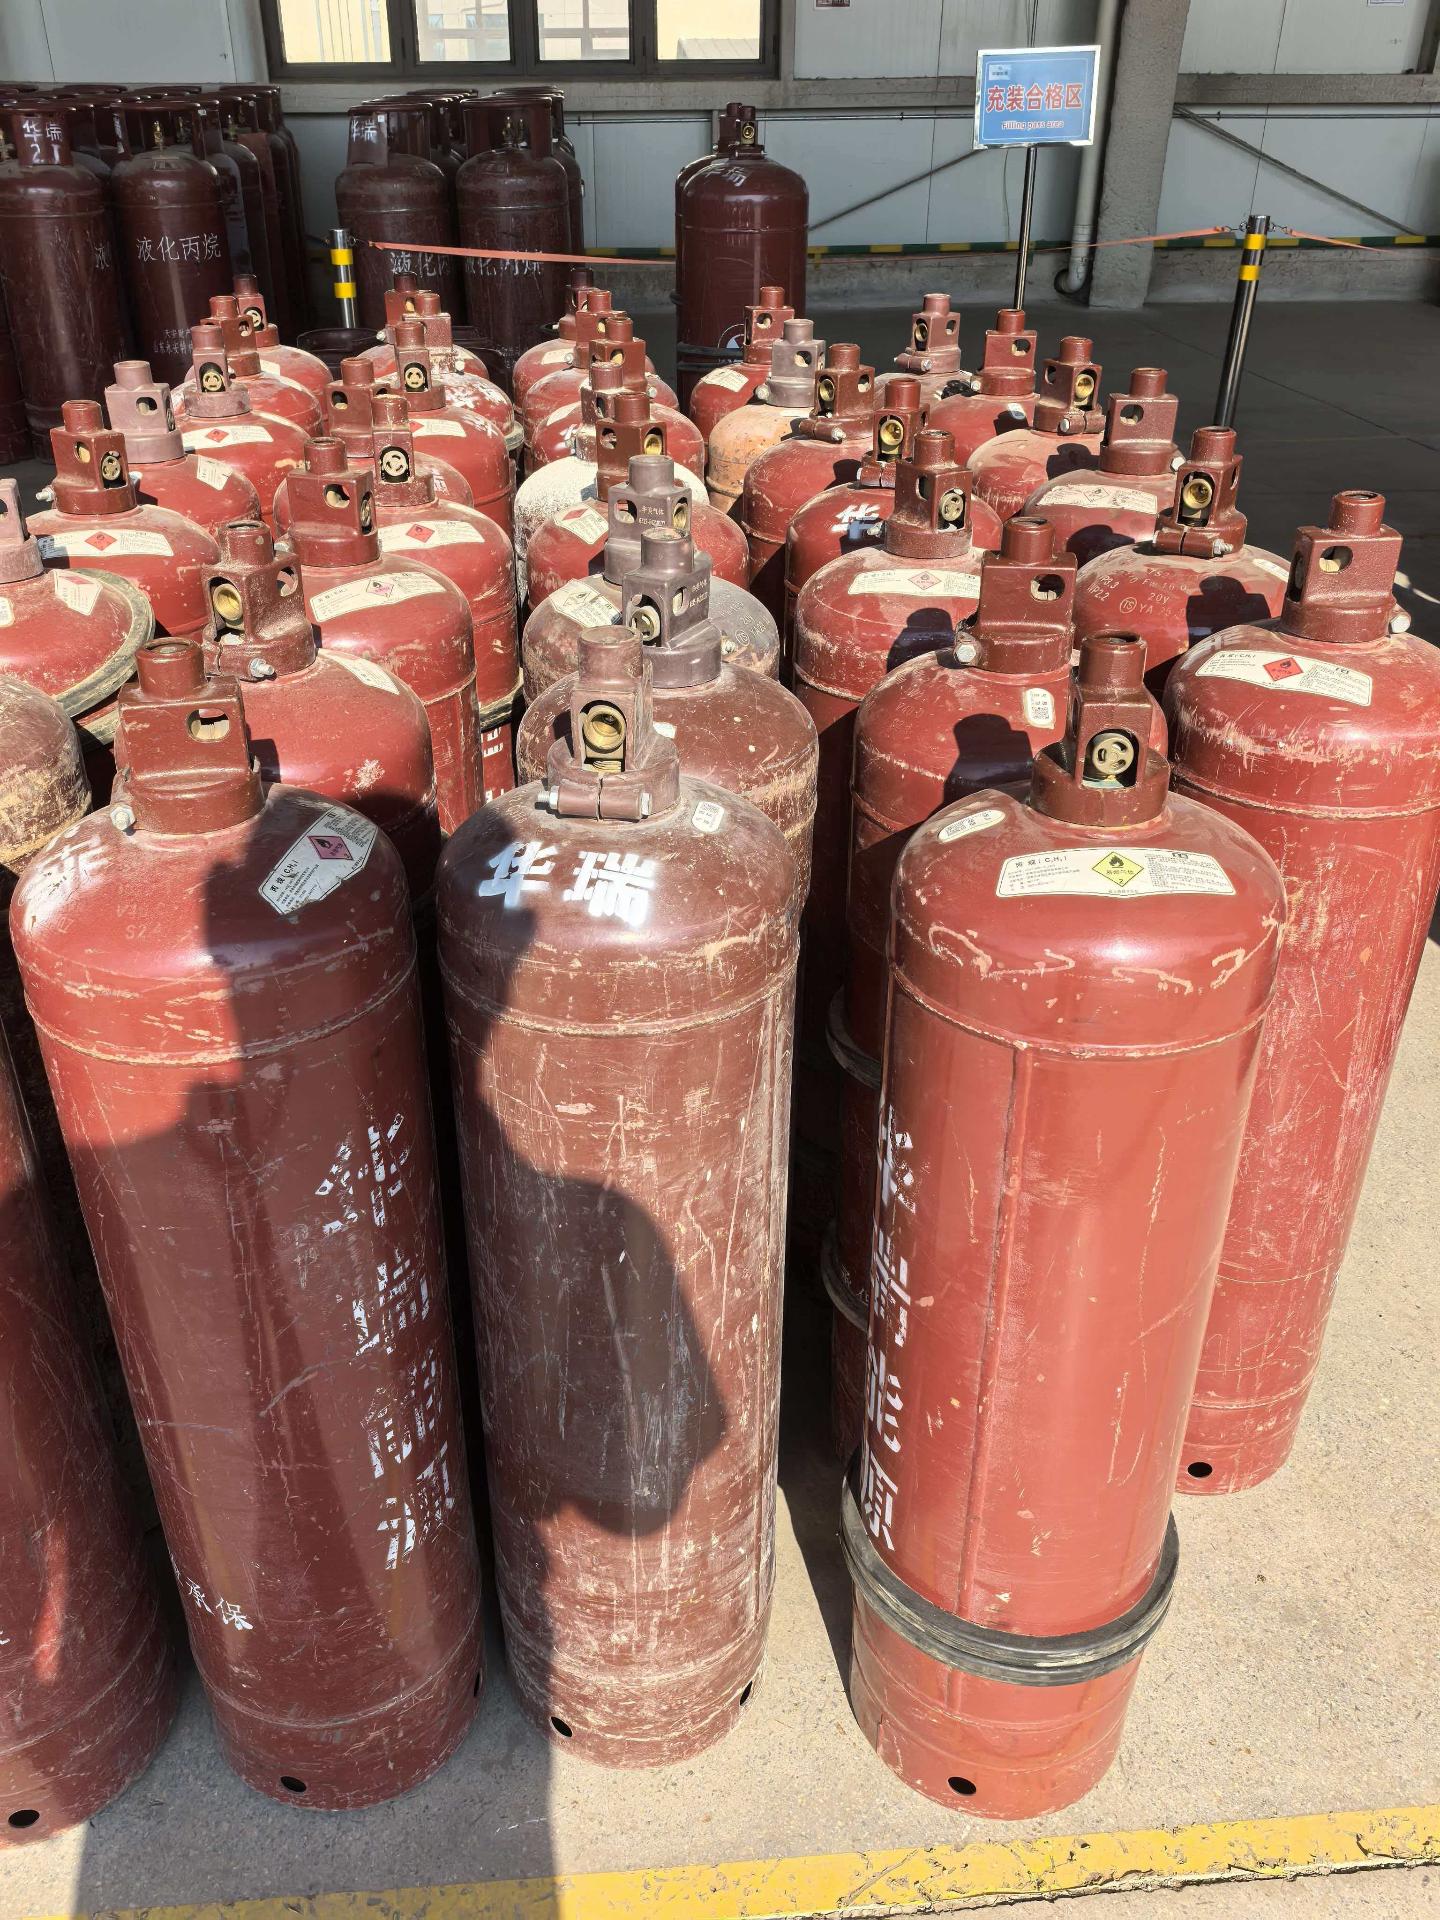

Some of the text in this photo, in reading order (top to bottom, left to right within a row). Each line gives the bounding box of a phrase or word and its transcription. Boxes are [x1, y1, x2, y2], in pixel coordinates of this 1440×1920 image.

[986, 83, 1083, 113] 充装合格区
[1002, 120, 1026, 131] Filling
[136, 233, 221, 262] 液化丙烷
[478, 840, 657, 928] 华瑞
